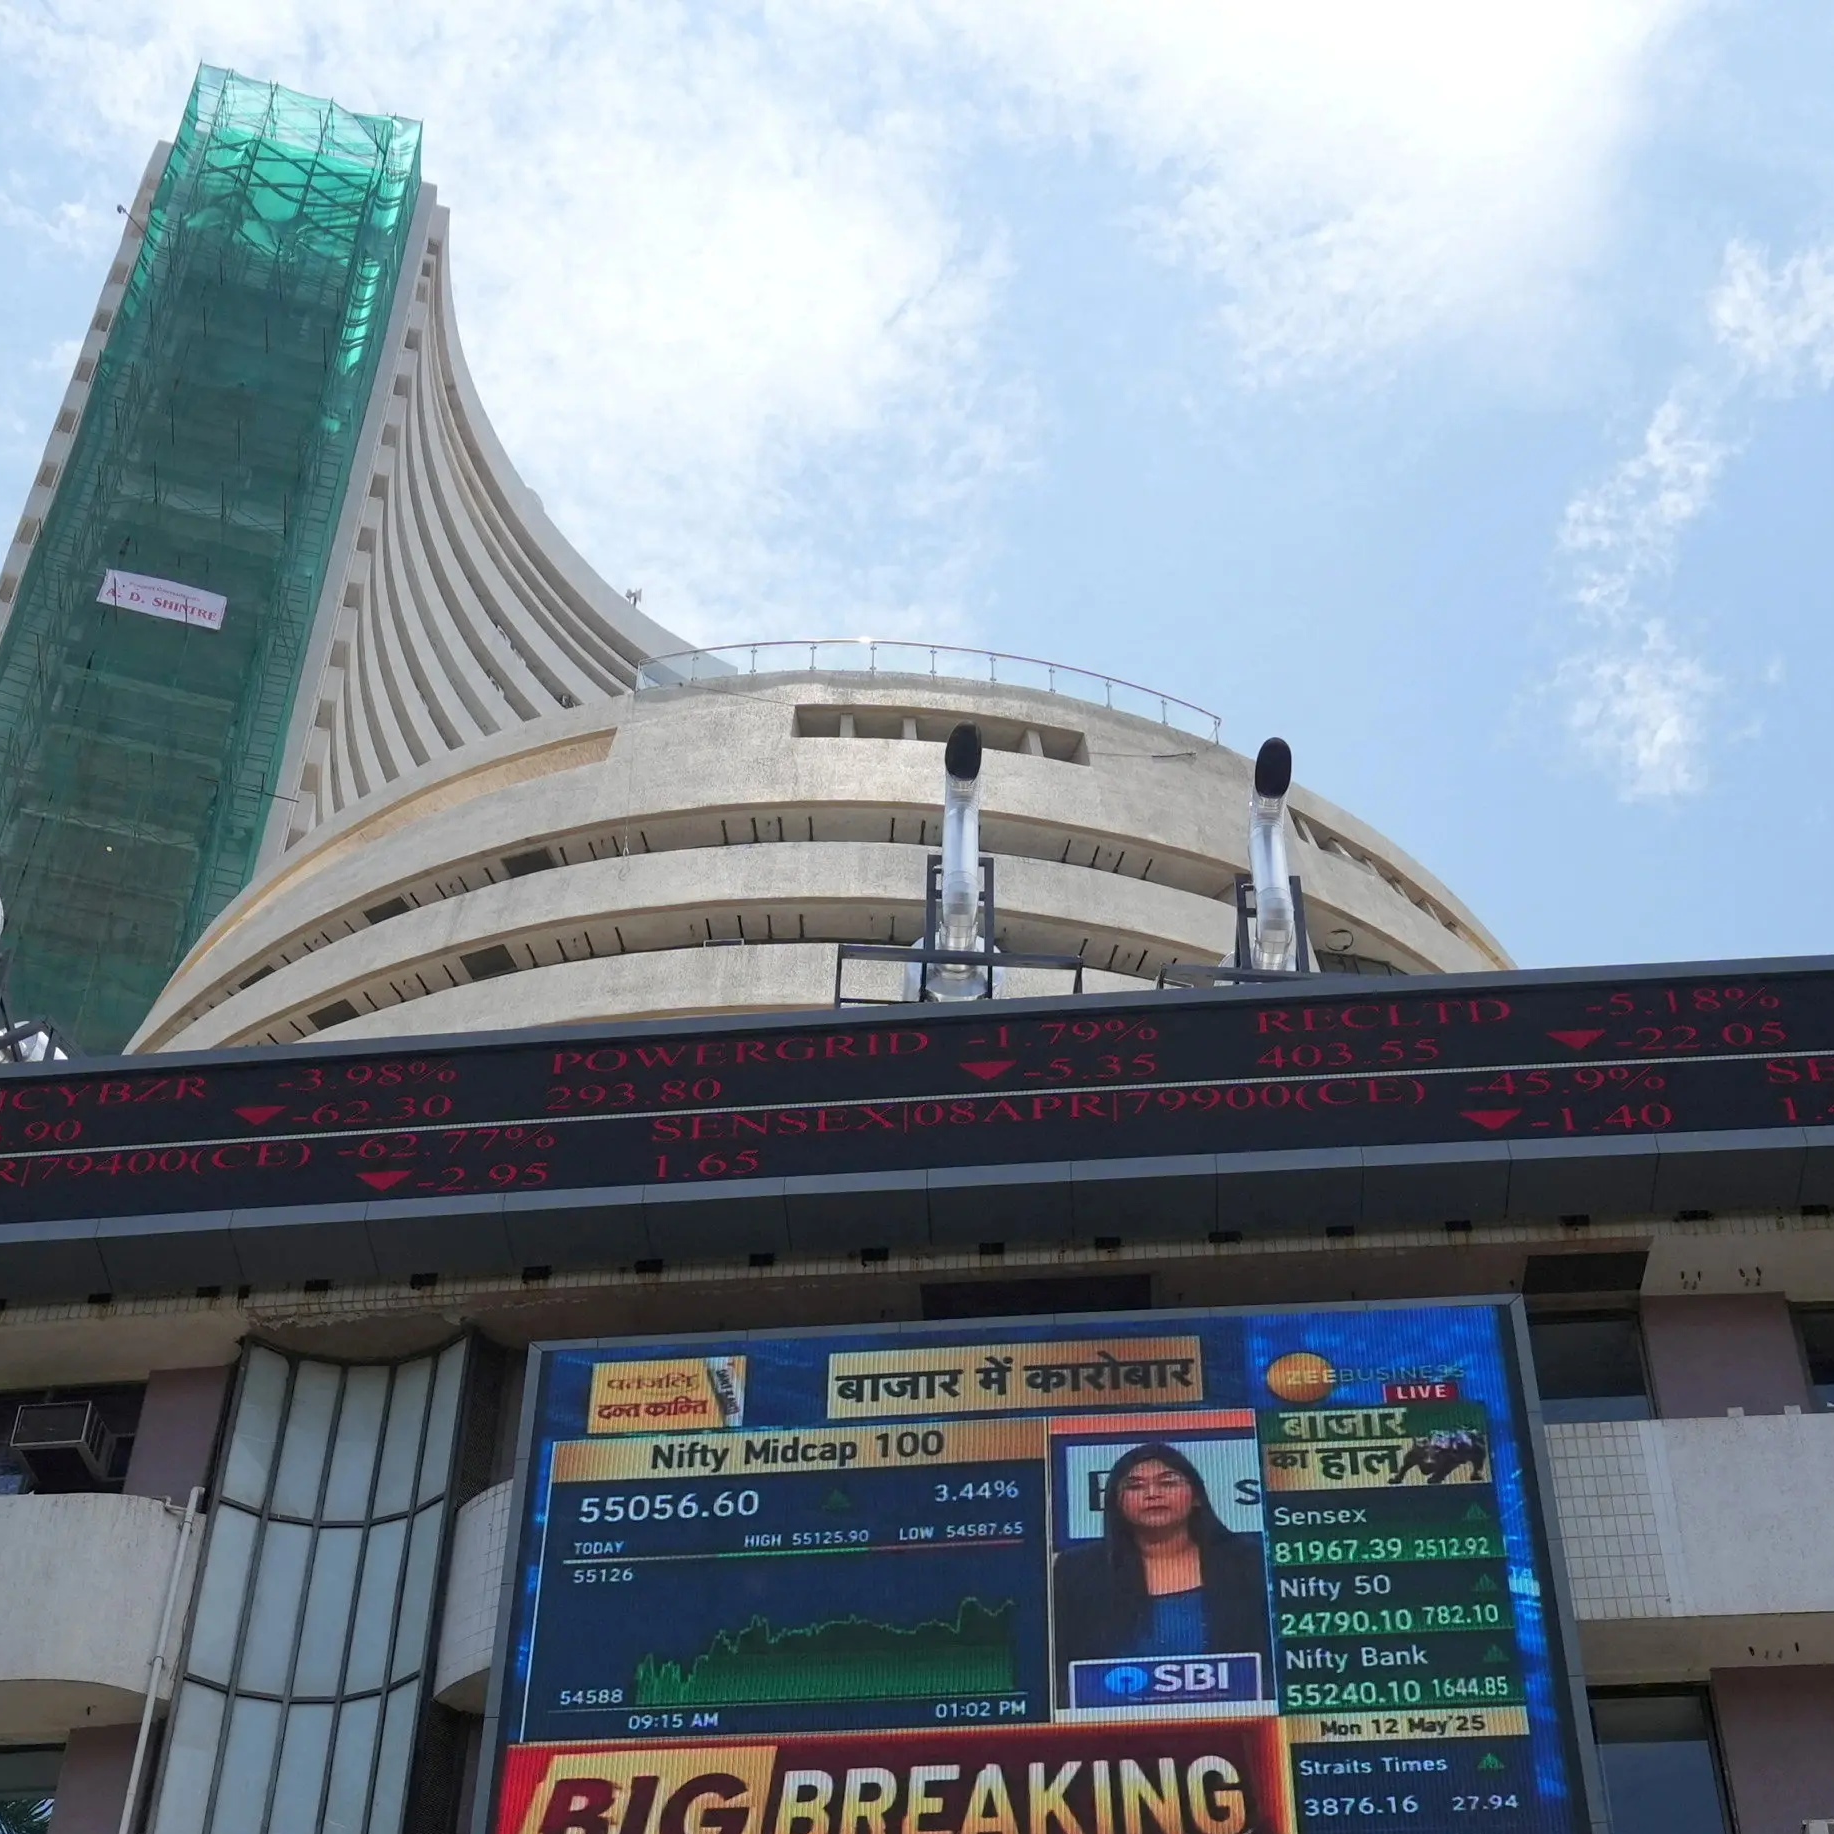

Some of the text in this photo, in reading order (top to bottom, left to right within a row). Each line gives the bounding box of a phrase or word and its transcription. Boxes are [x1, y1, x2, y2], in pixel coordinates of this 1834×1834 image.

[129, 592, 145, 604] D.
[152, 597, 217, 622] SHINTRE
[1257, 998, 1512, 1035] RECLTD
[1585, 985, 1780, 1017] -5.18%
[967, 1017, 1159, 1049] -1.79%
[1615, 1020, 1788, 1051] -22.05
[552, 1031, 930, 1075] POWERGRID
[1023, 1053, 1159, 1081] -5.35
[1255, 1037, 1440, 1069] 403.55
[278, 1060, 457, 1091] -3.98%
[1465, 1065, 1666, 1096] -45.9%
[546, 1077, 723, 1111] 293.80
[291, 1095, 453, 1125] -62.30
[1529, 1101, 1674, 1132] -1.40
[337, 1126, 557, 1159] -62.77%
[417, 1161, 549, 1191] -2.95
[655, 1149, 760, 1180] 1.65
[834, 1350, 1195, 1402] बाजार में कारोबार
[1396, 1384, 1448, 1400] LIVE
[1278, 1406, 1409, 1440] बाजार
[651, 1430, 945, 1473] Nifty Midcap 100
[1268, 1444, 1404, 1480] का हाल
[578, 1479, 1020, 1523] 55056.60 3.44%
[1274, 1505, 1367, 1526] Sensex
[574, 1521, 1023, 1555] TODAY HIGH 55125.90 LOW 54587.65
[1275, 1535, 1490, 1564] 81967.39 2512.92
[573, 1567, 635, 1583] 55126
[1280, 1573, 1392, 1602] Nifty 50
[1280, 1603, 1500, 1637] 24790.10 782.10
[1286, 1644, 1429, 1674] Nifty Bank
[1153, 1661, 1230, 1692] SBI
[1286, 1675, 1509, 1707] 55240.10 1644.85
[560, 1688, 624, 1705] 54588
[935, 1699, 1027, 1719] 01:02 PM
[628, 1711, 719, 1730] 09:15 AM
[1320, 1720, 1362, 1736] Mon
[1371, 1717, 1399, 1734] 12
[1299, 1755, 1448, 1776] Straits Times
[1304, 1793, 1519, 1817] 3876.16 27.94
